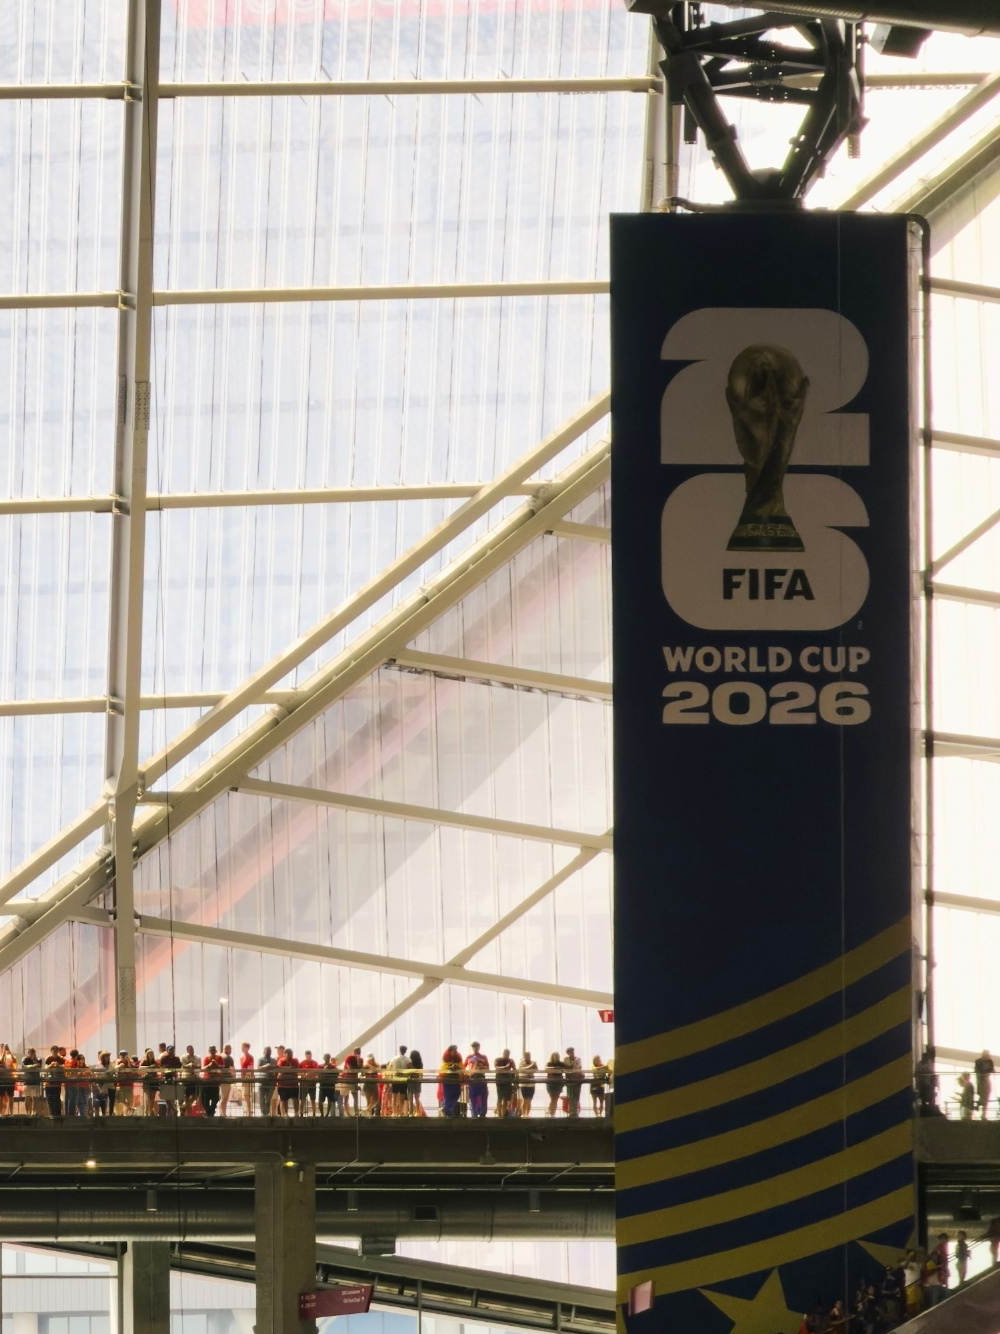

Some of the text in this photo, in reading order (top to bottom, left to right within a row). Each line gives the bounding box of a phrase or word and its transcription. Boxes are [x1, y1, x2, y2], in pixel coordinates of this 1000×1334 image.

[722, 568, 815, 601] FIFA
[662, 646, 871, 673] WORLD CUP
[662, 681, 872, 726] 2026
